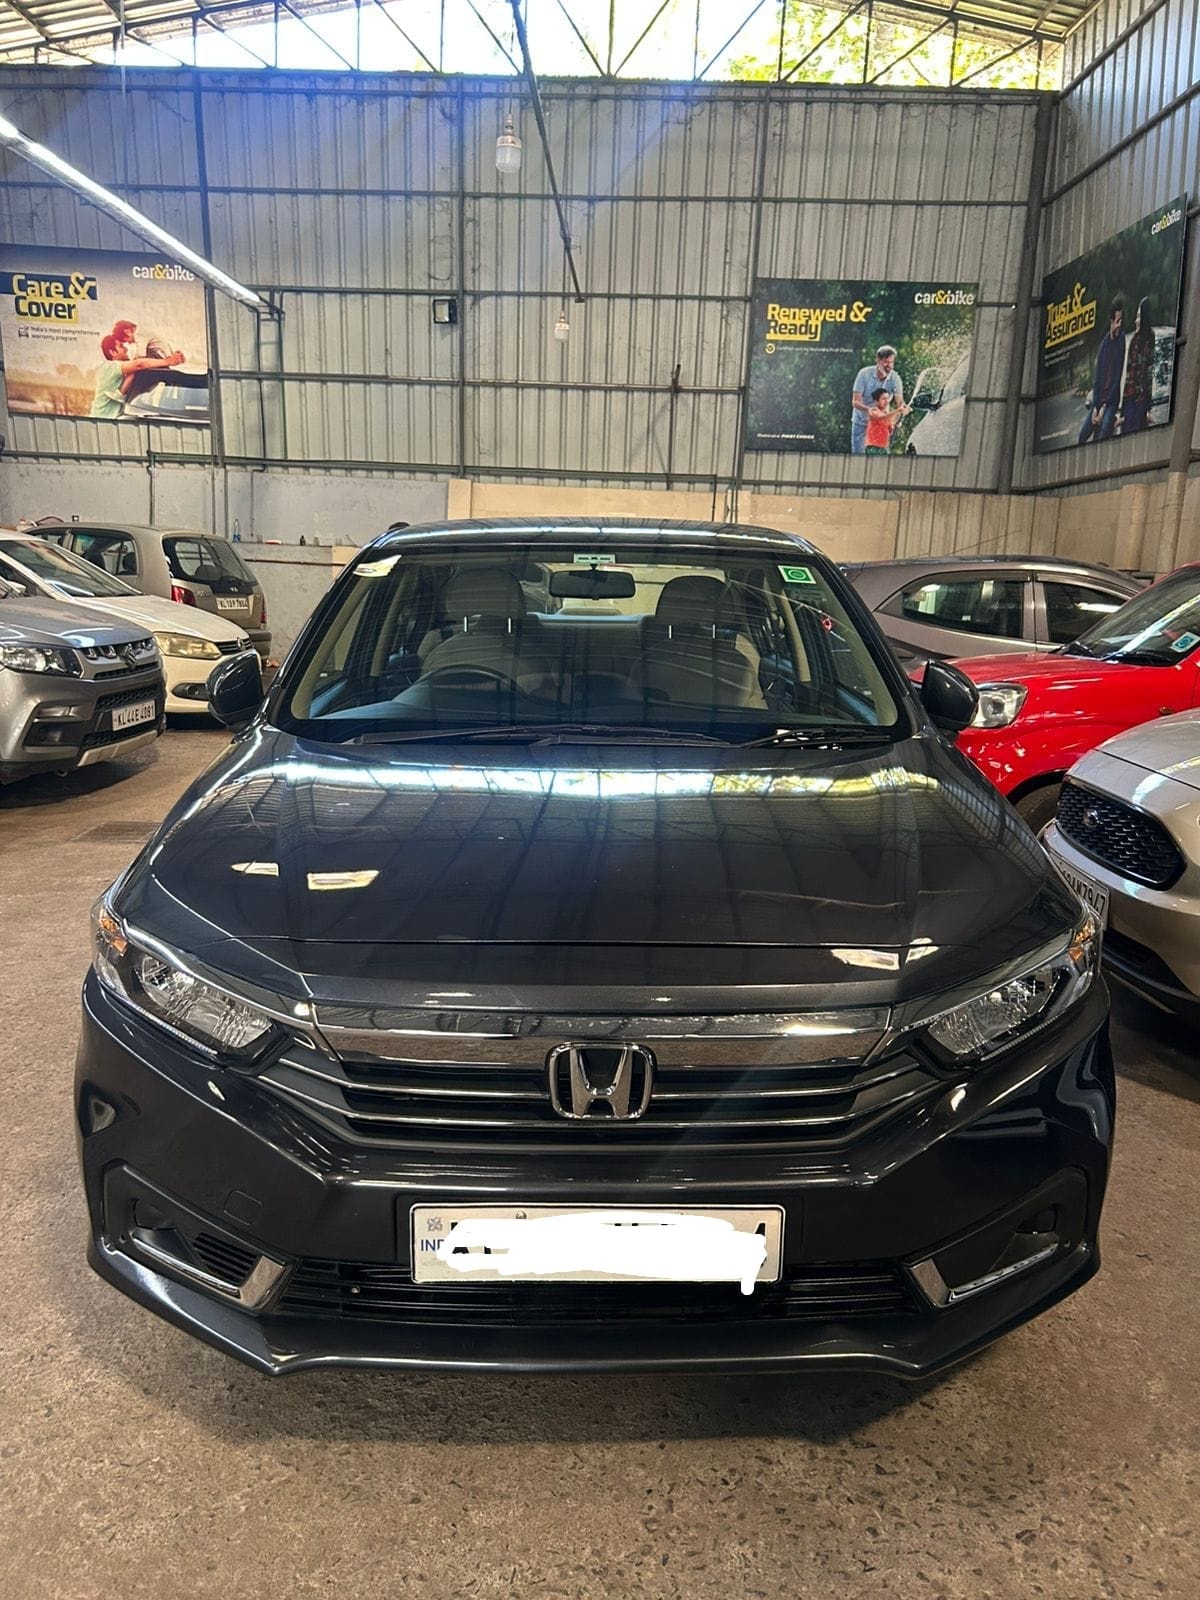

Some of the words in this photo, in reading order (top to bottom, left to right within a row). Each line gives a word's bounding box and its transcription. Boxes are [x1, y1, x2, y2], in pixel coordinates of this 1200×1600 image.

[1151, 208, 1182, 235] car&bike
[132, 264, 195, 282] car&bike
[12, 274, 64, 298] Care
[69, 272, 97, 300] &
[914, 290, 974, 306] car&bike
[15, 295, 76, 319] Cover
[767, 303, 847, 322] Renewed
[849, 301, 872, 322] &
[1047, 294, 1072, 324] Trust
[1072, 282, 1087, 312] &
[768, 319, 819, 339] Ready
[1045, 307, 1095, 341] Assurance
